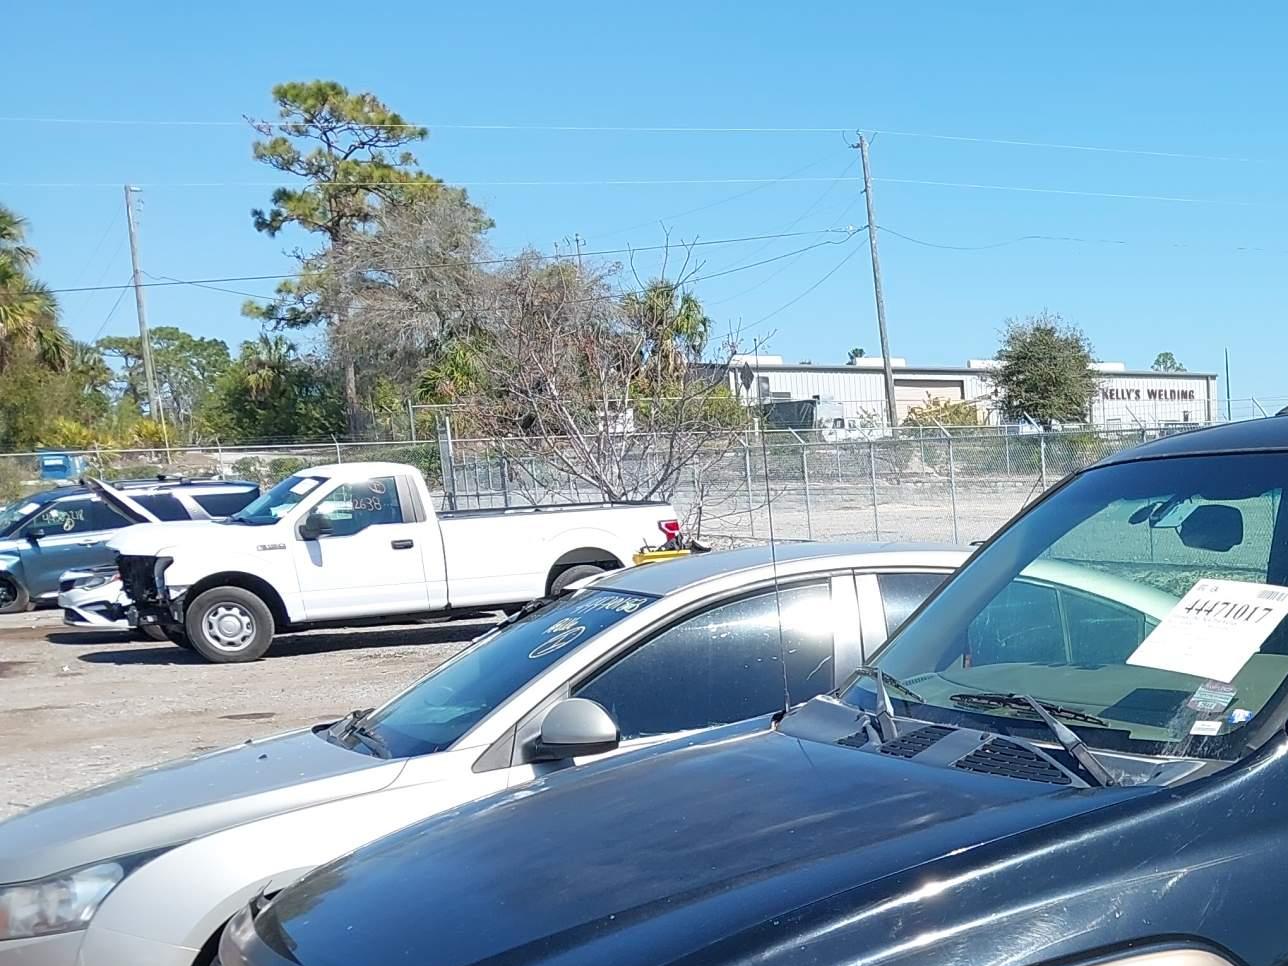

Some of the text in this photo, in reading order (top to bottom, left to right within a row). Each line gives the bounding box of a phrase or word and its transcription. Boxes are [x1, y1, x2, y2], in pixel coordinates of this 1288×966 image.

[1101, 388, 1195, 401] KELLY'S WELDING
[1185, 599, 1273, 623] 44471017
